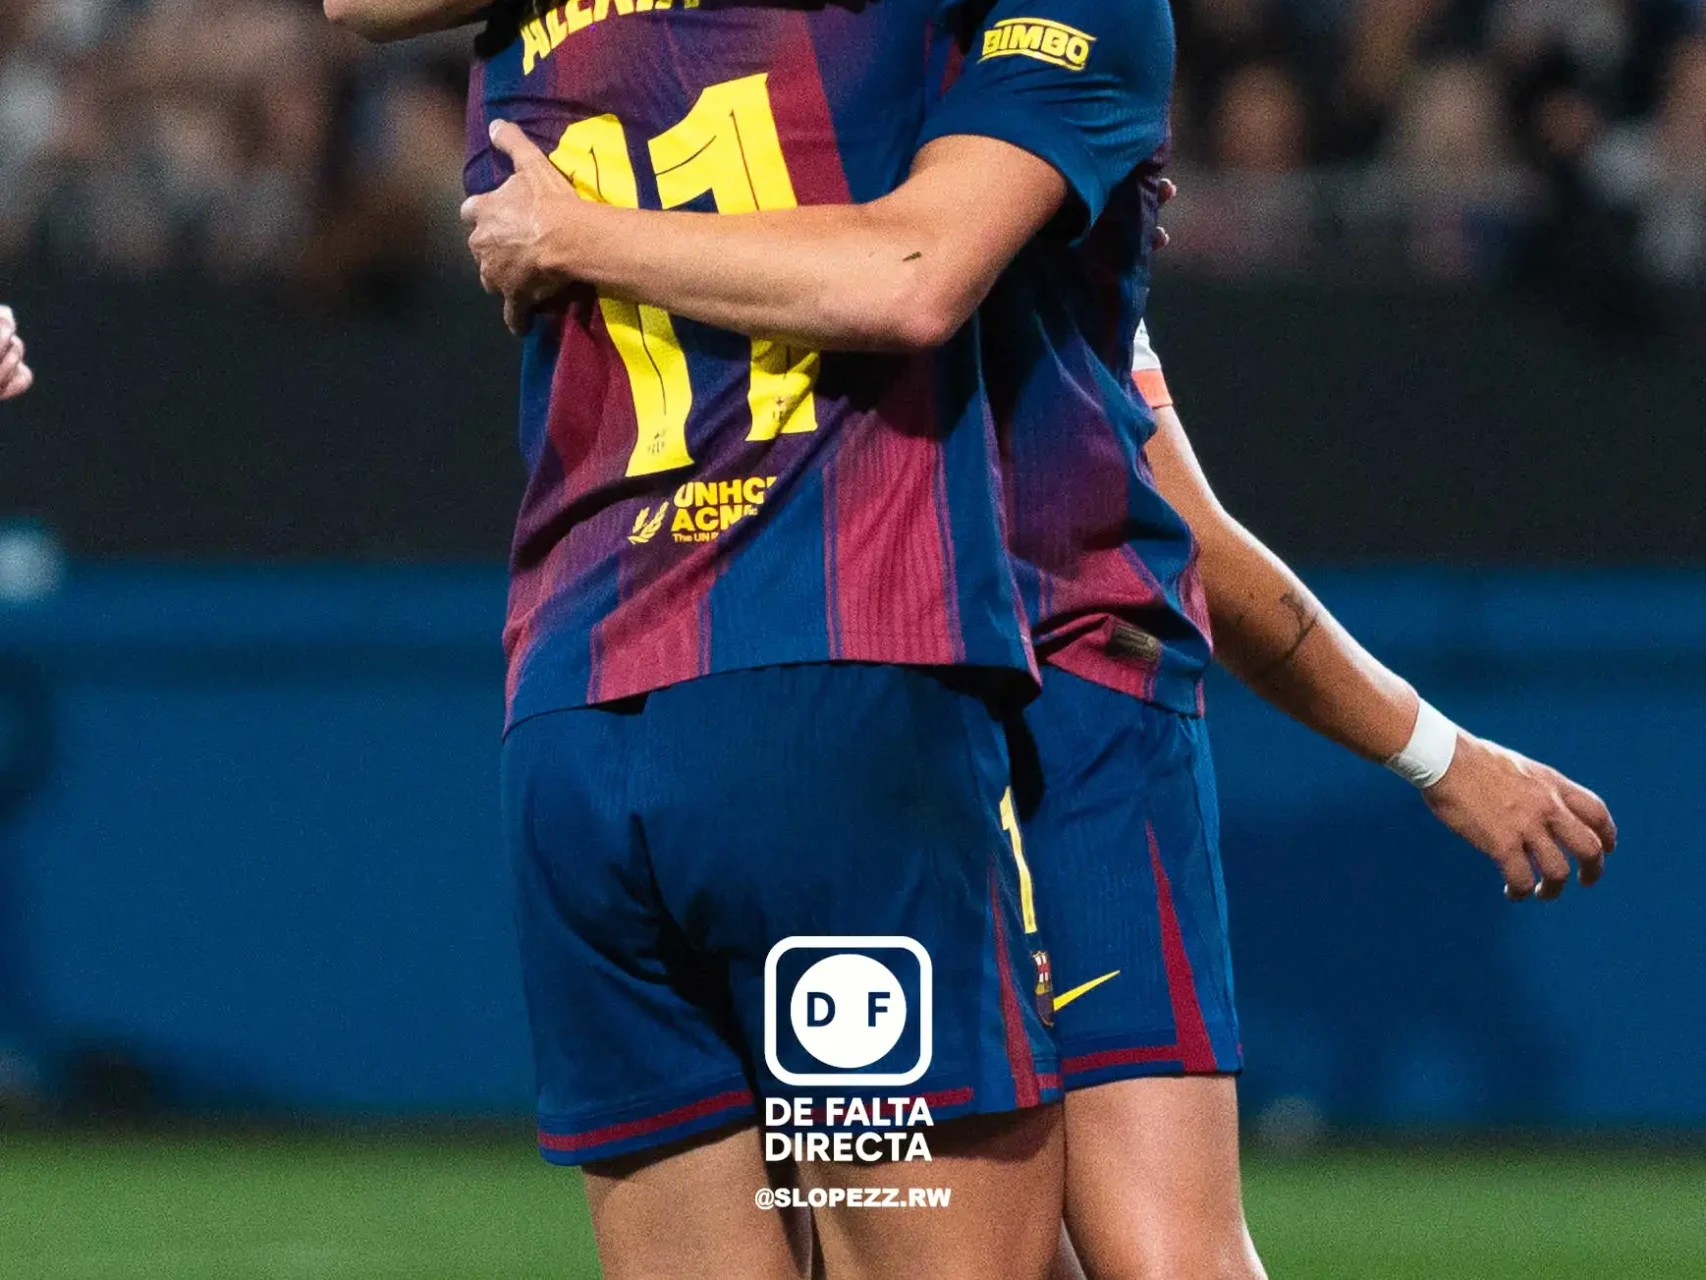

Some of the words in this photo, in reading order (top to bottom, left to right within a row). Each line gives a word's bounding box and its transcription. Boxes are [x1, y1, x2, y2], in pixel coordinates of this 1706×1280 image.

[982, 23, 1089, 65] BIMBO
[549, 73, 819, 477] 11
[673, 477, 777, 508] UNHC
[671, 504, 757, 532] ACN
